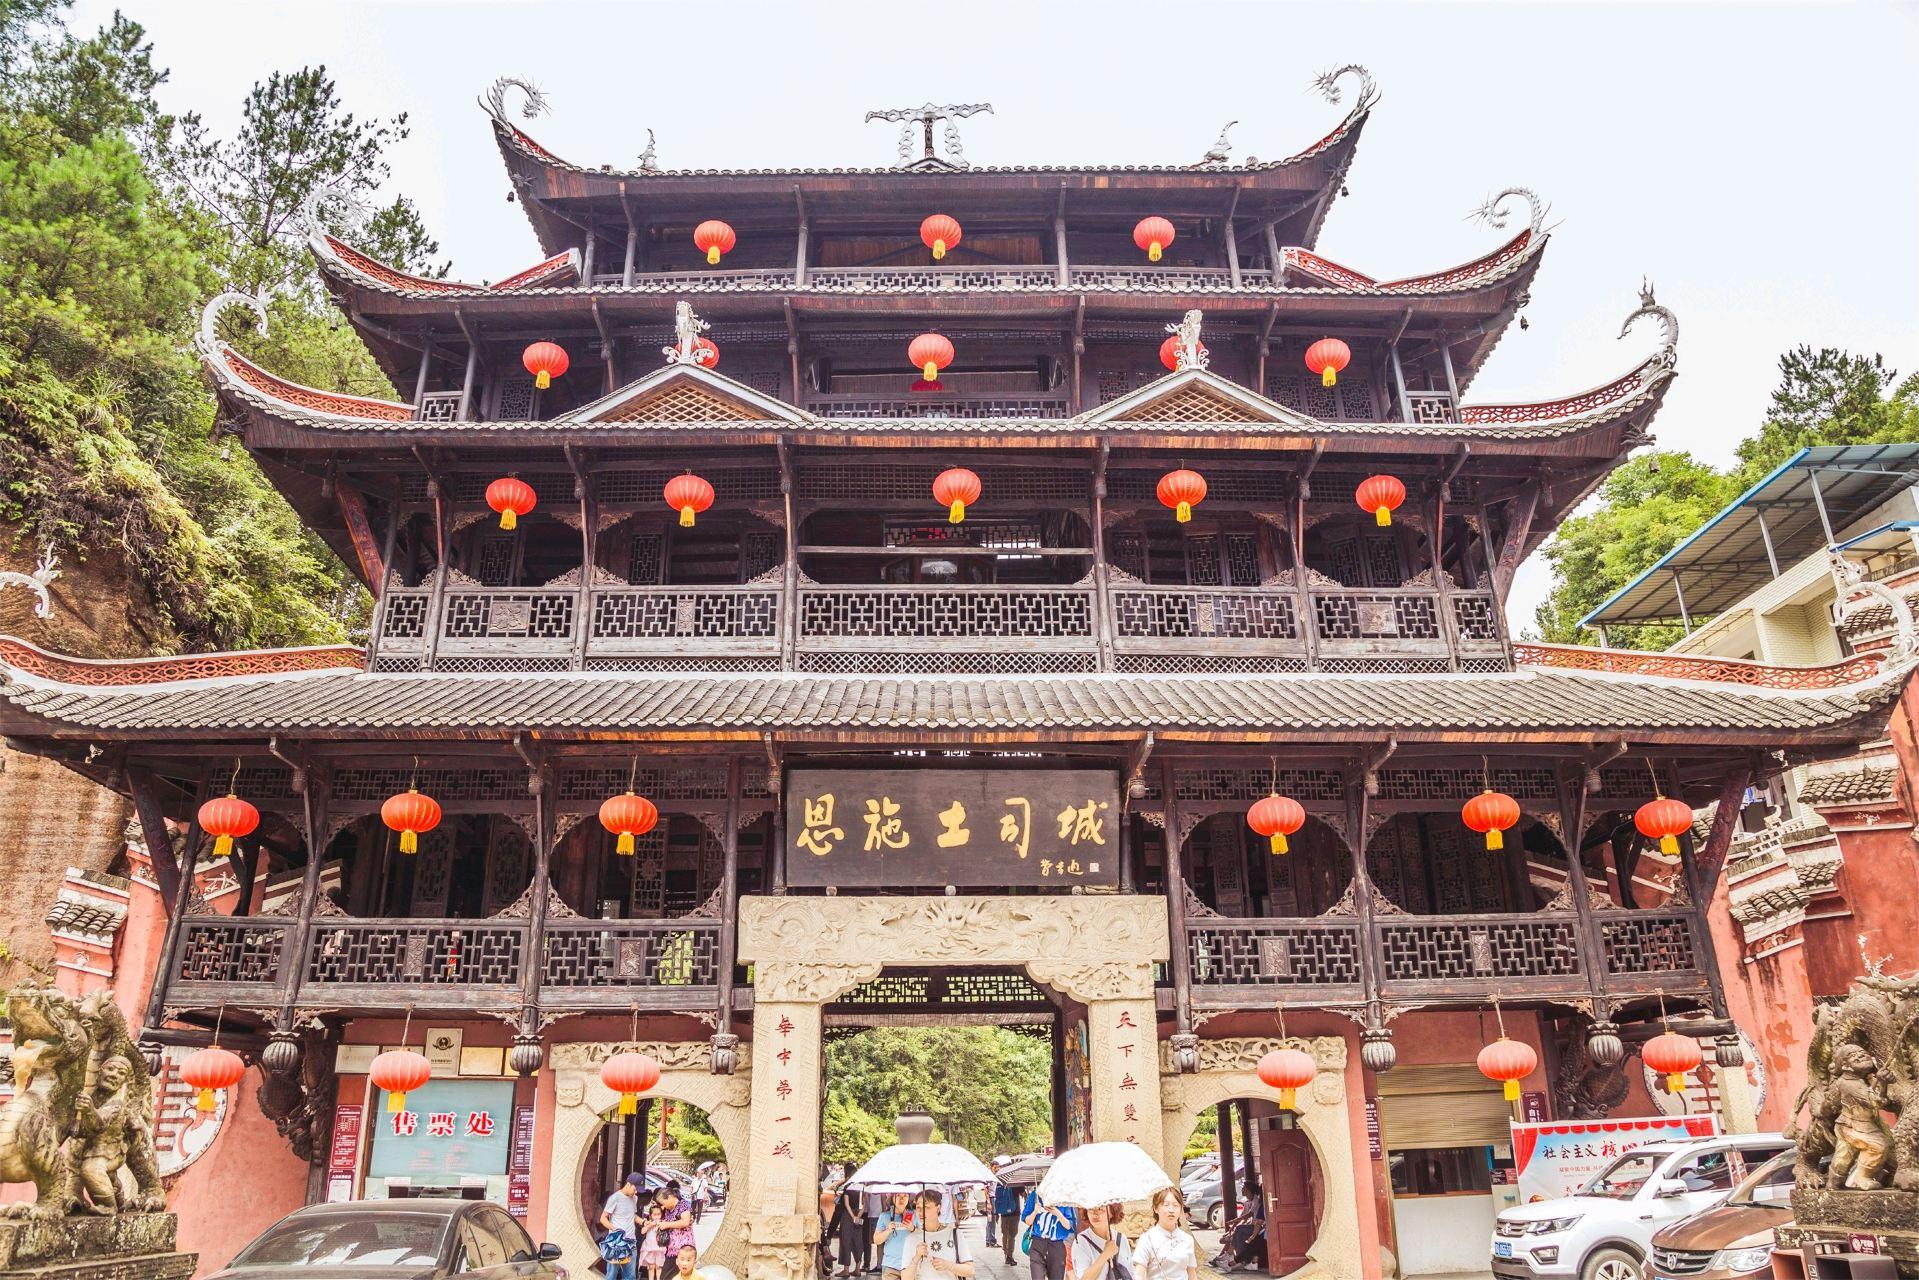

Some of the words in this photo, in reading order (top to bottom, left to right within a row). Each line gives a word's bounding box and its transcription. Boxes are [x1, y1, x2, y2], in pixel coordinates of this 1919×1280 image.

[796, 793, 1108, 859] 恩施土司城
[391, 1110, 495, 1137] 售票处
[1542, 1140, 1651, 1160] 社会主义核心
